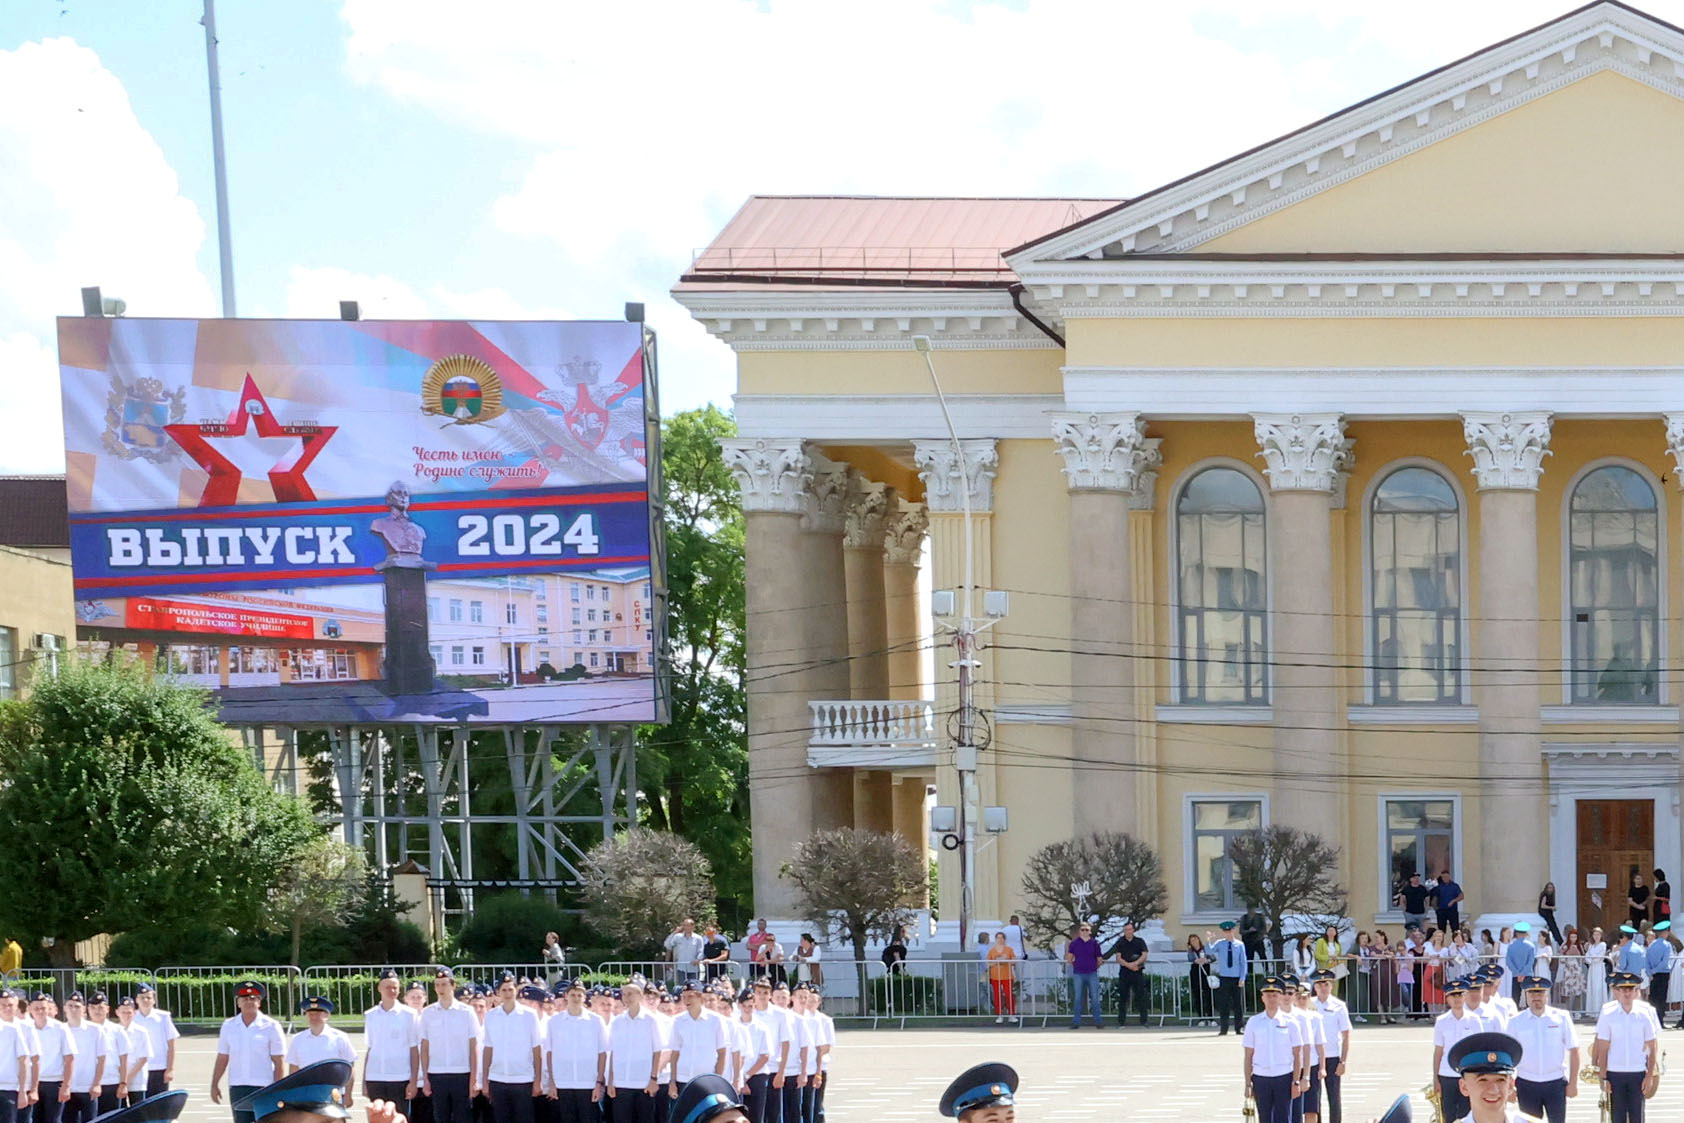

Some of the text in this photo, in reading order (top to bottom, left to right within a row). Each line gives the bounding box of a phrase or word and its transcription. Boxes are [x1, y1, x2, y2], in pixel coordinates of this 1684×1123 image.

[412, 446, 458, 461] Честь
[413, 463, 541, 483] Родине служить!
[107, 513, 599, 566] ВЫПУСК 2024
